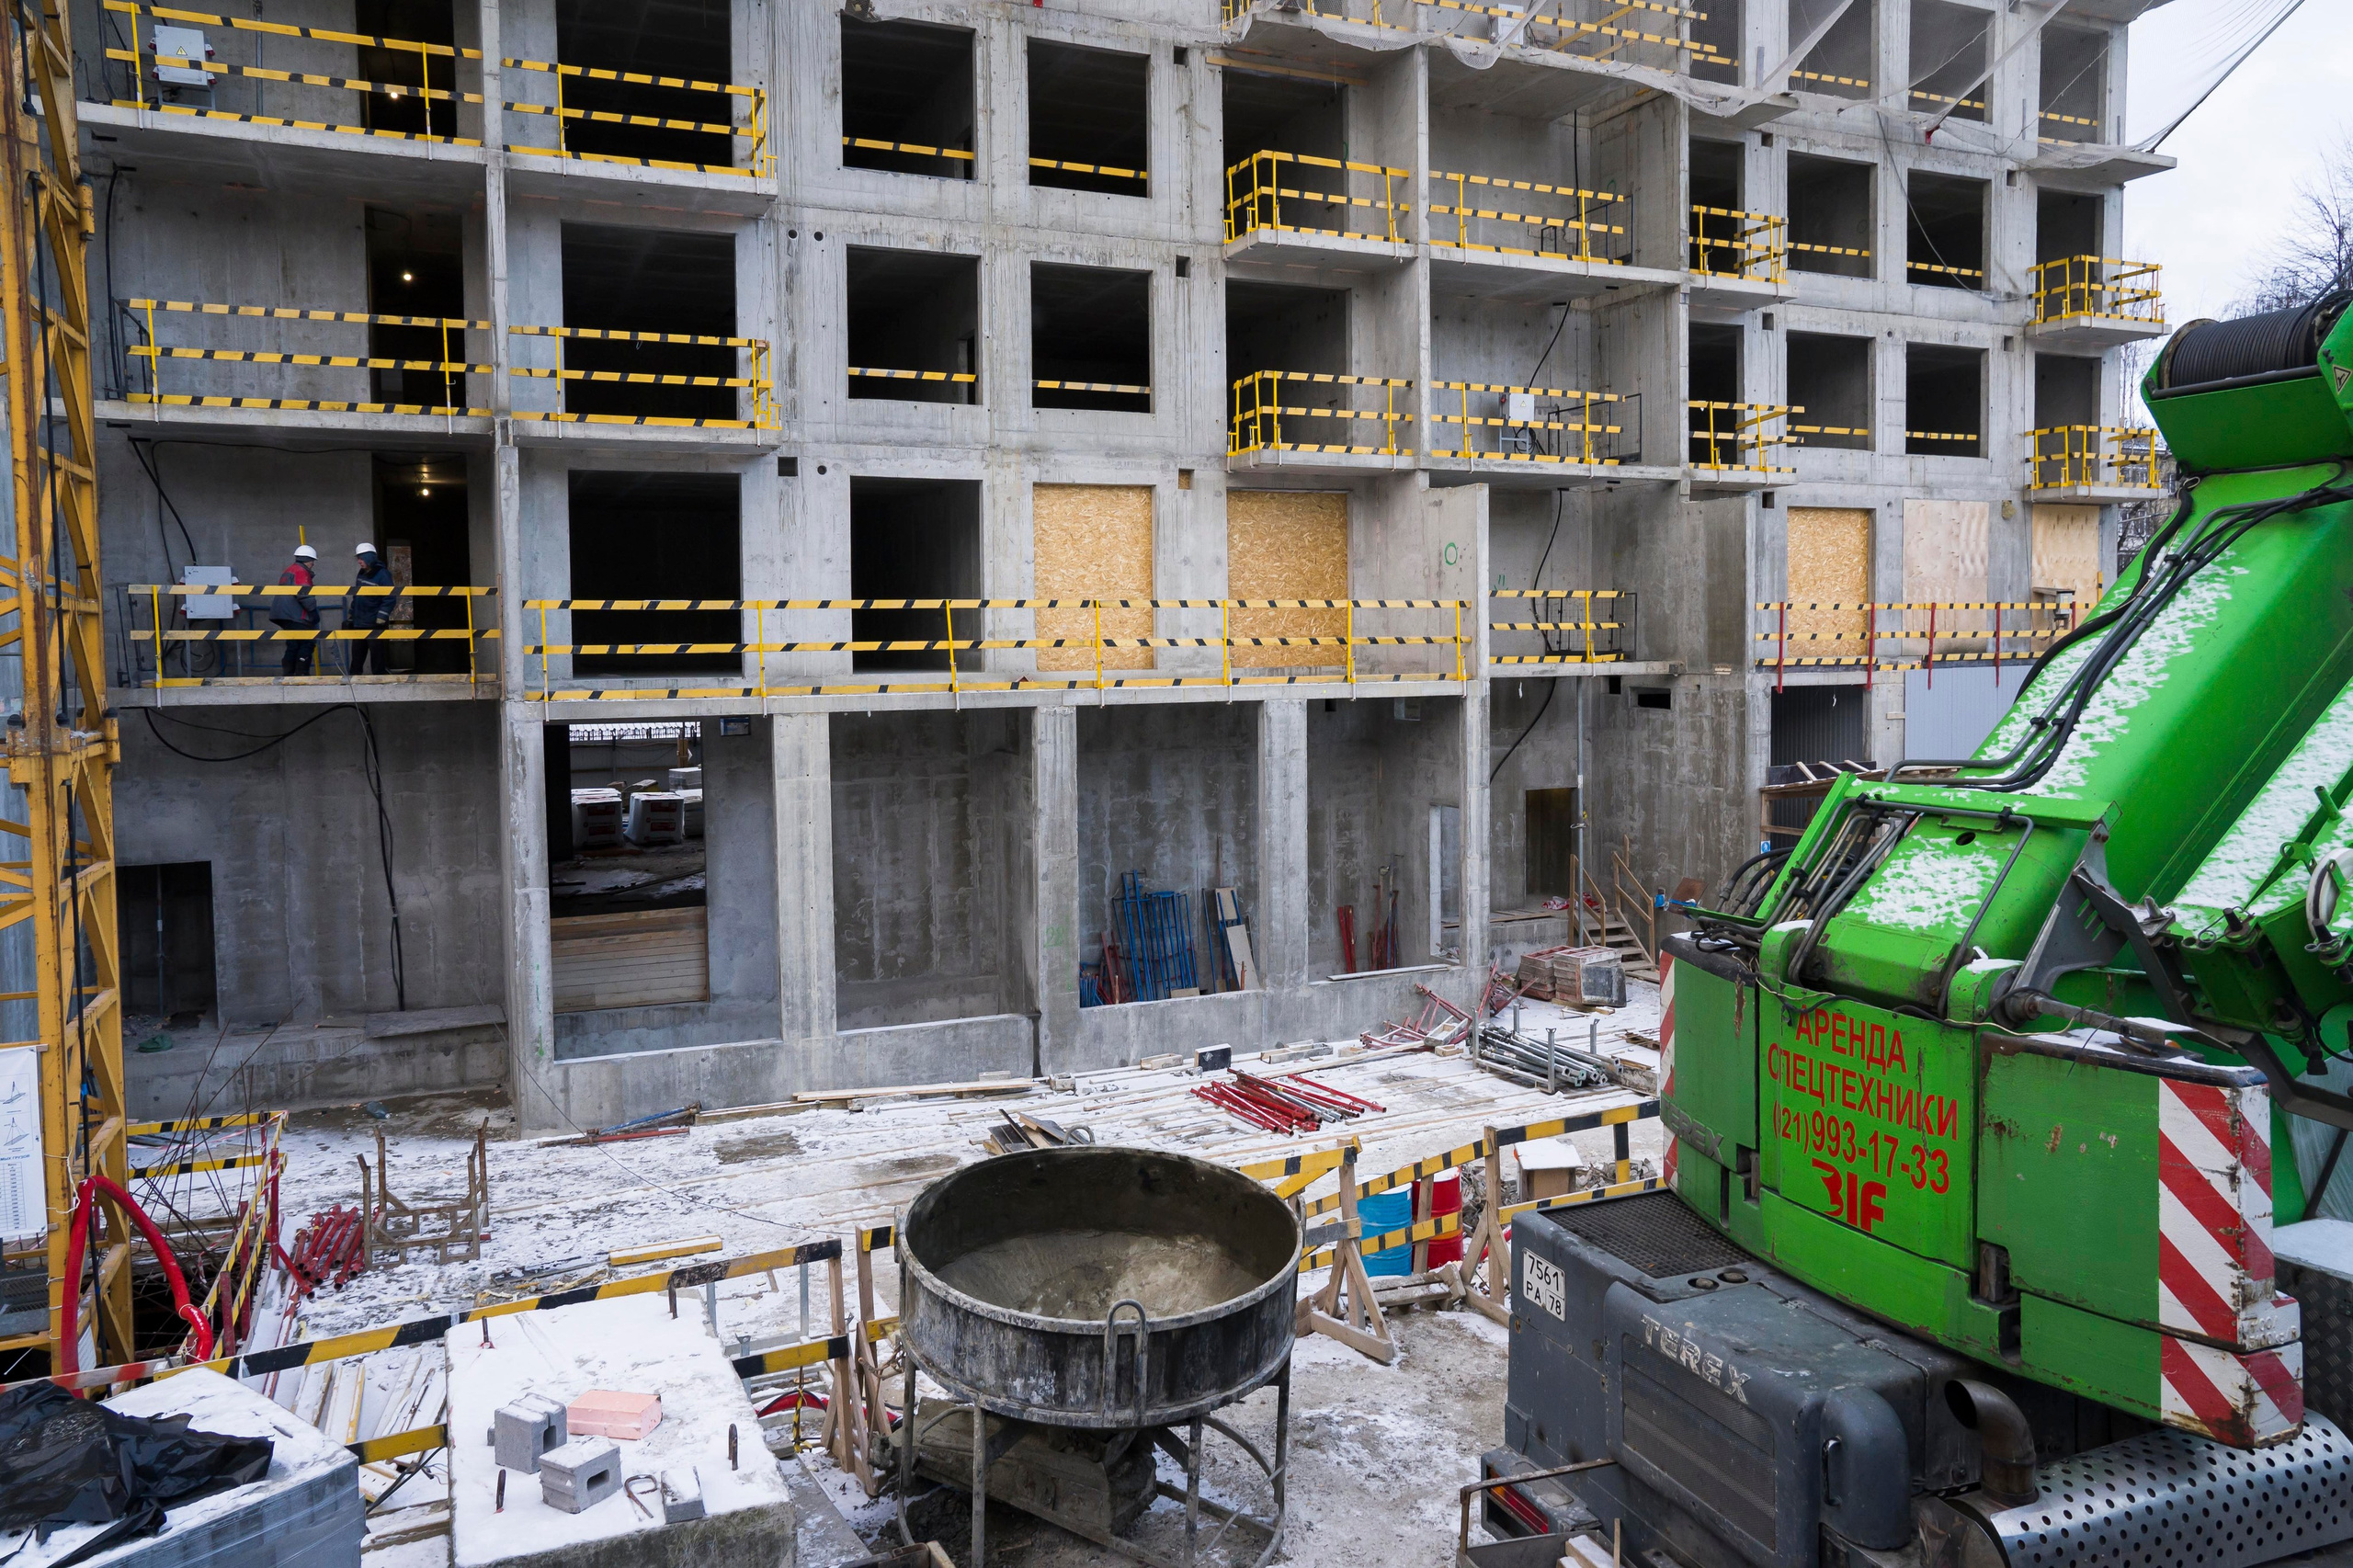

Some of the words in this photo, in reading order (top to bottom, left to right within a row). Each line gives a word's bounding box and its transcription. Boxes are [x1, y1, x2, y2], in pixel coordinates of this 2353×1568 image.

[1795, 1005, 1907, 1075] АРЕНДА
[1768, 1042, 1958, 1141] СПЕЦТЕХНИКИ
[1528, 1254, 1560, 1292] 7561
[1549, 1294, 1563, 1316] 78
[1640, 1312, 1752, 1405] TEREX
